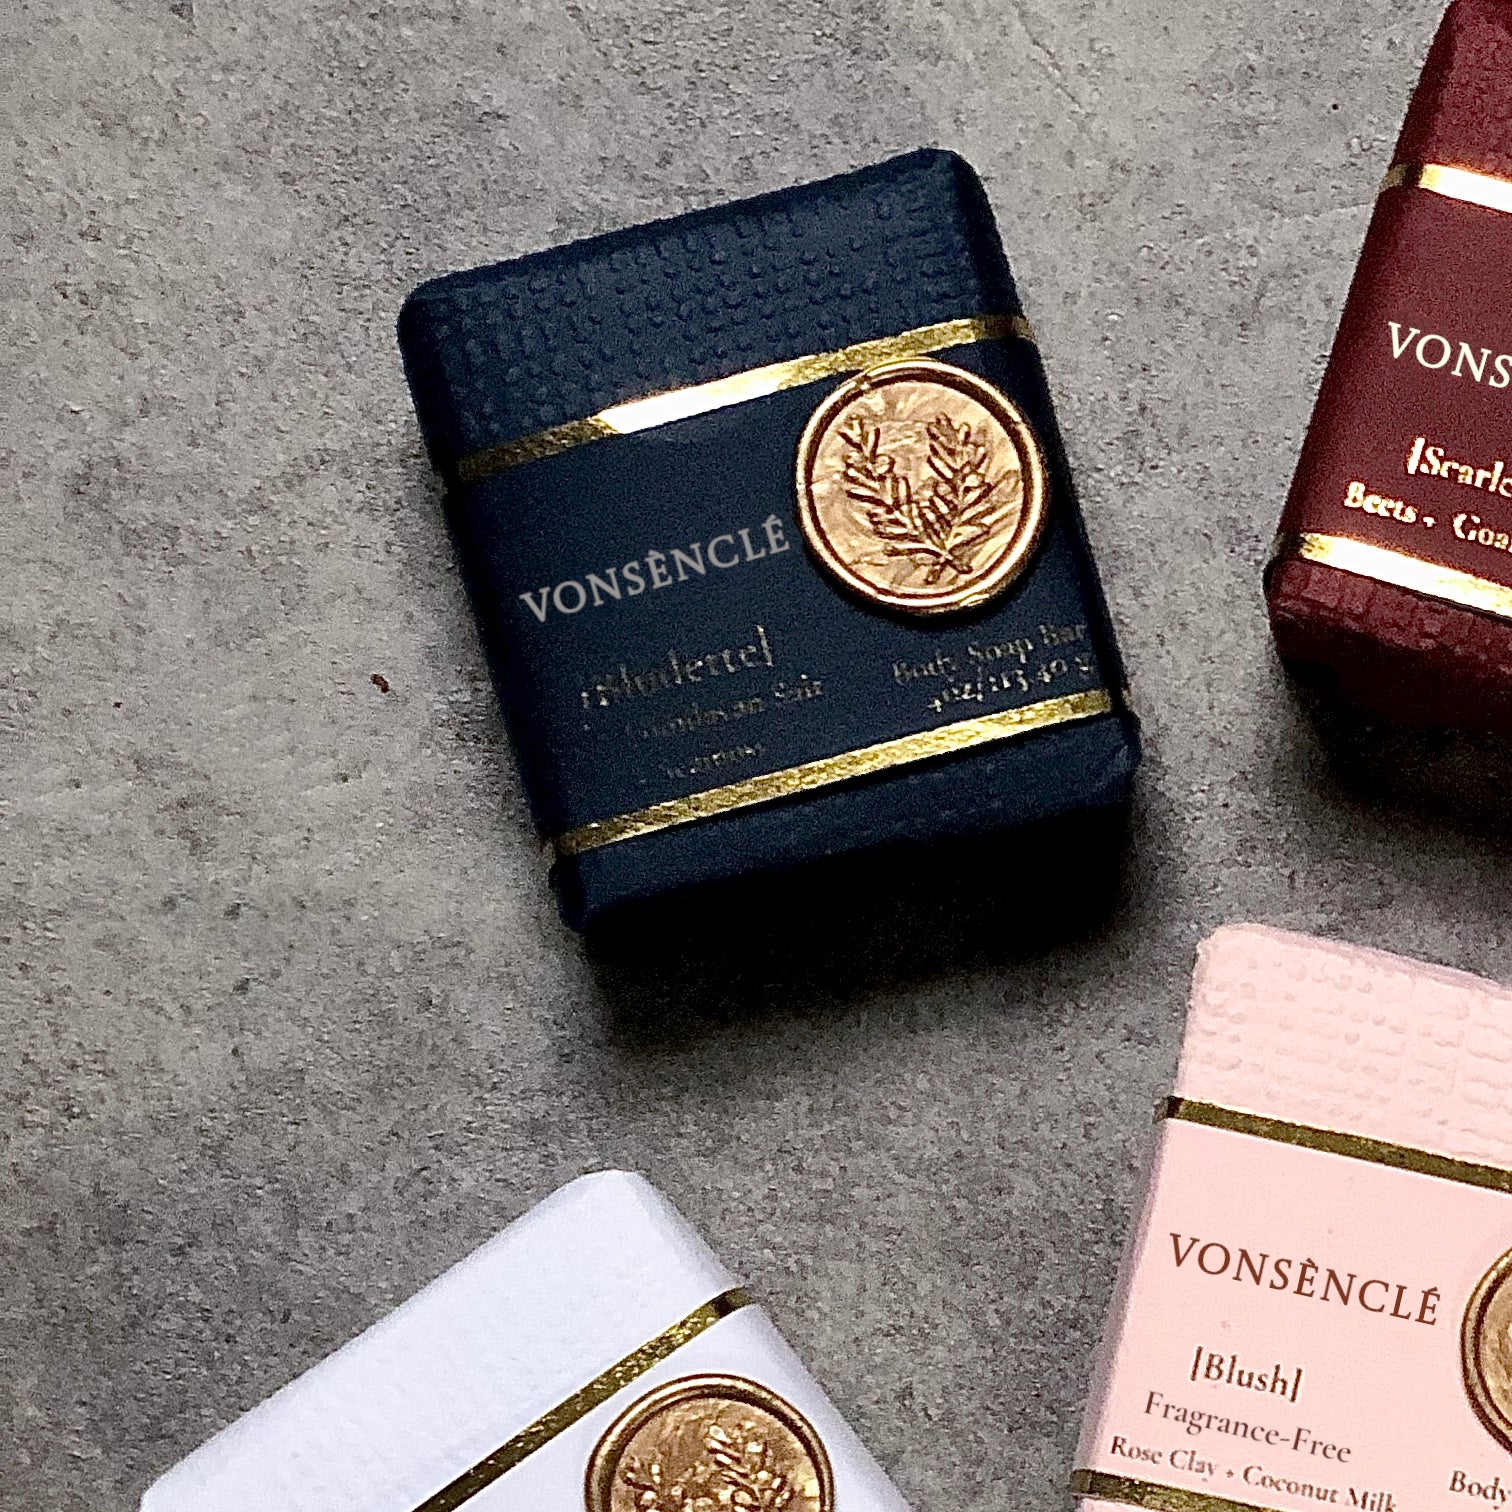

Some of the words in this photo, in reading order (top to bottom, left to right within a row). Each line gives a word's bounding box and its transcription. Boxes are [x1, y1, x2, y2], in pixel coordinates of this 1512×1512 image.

[1343, 480, 1418, 523] Beets
[1168, 1232, 1441, 1326] VONSÈNCLÉ
[1143, 1390, 1352, 1464] Fragrance-Free
[1110, 1435, 1163, 1467] Rose
[1169, 1446, 1218, 1481] Clay
[1242, 1465, 1339, 1505] Coconut
